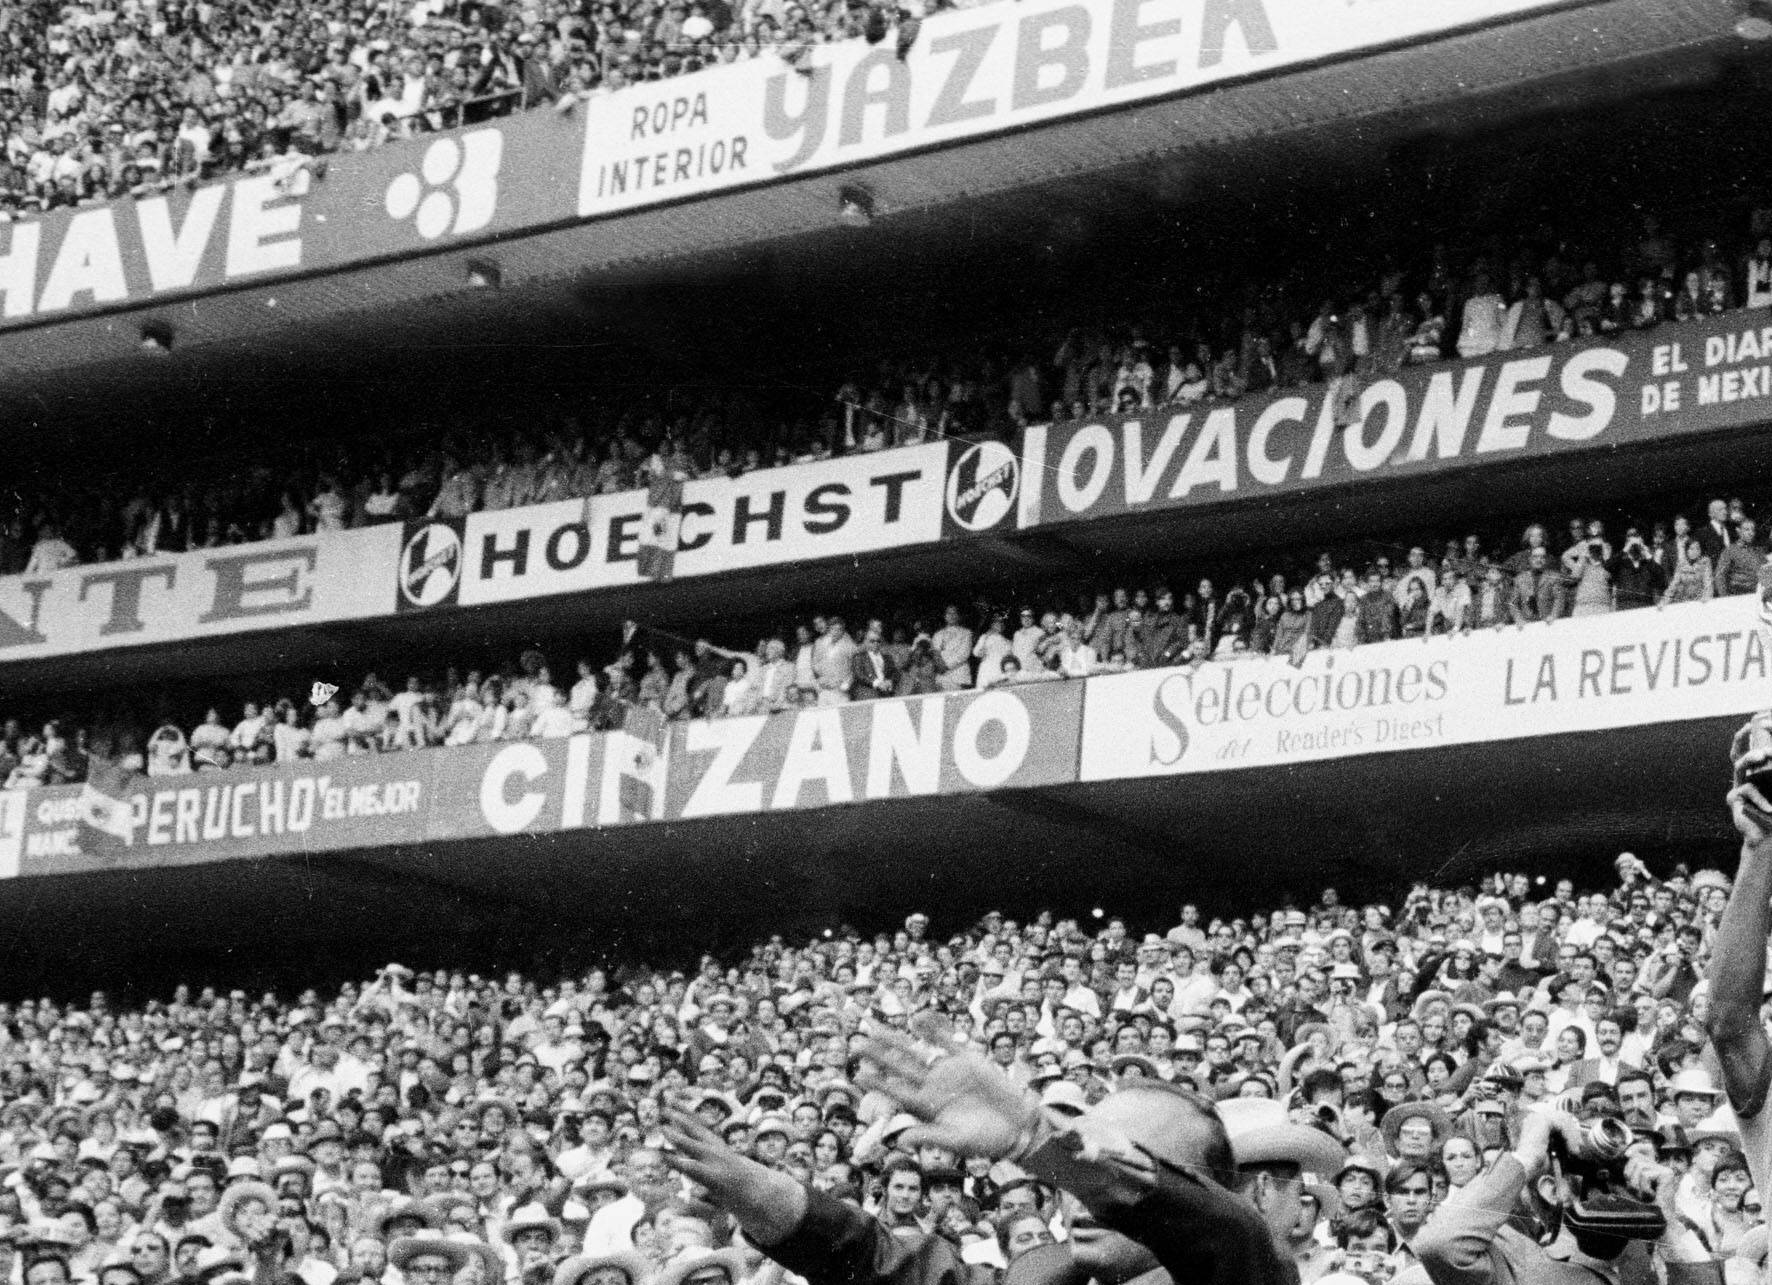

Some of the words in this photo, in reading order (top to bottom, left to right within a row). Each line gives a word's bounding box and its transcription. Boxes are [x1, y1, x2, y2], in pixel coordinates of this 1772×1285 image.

[631, 92, 708, 142] ROPA
[598, 136, 749, 199] INTERIOR
[1651, 342, 1688, 377] EL
[1641, 381, 1681, 415] DE
[1057, 347, 1630, 514] OVACIONES
[479, 469, 922, 580] HOECHST
[1502, 652, 1559, 705] LA
[1578, 629, 1766, 700] REVISTA
[1148, 656, 1449, 766] Selecciones
[1277, 721, 1364, 754] Reader's
[1375, 713, 1444, 744] Digest
[479, 690, 1031, 835] CINZANO
[348, 780, 421, 817] MEJOR
